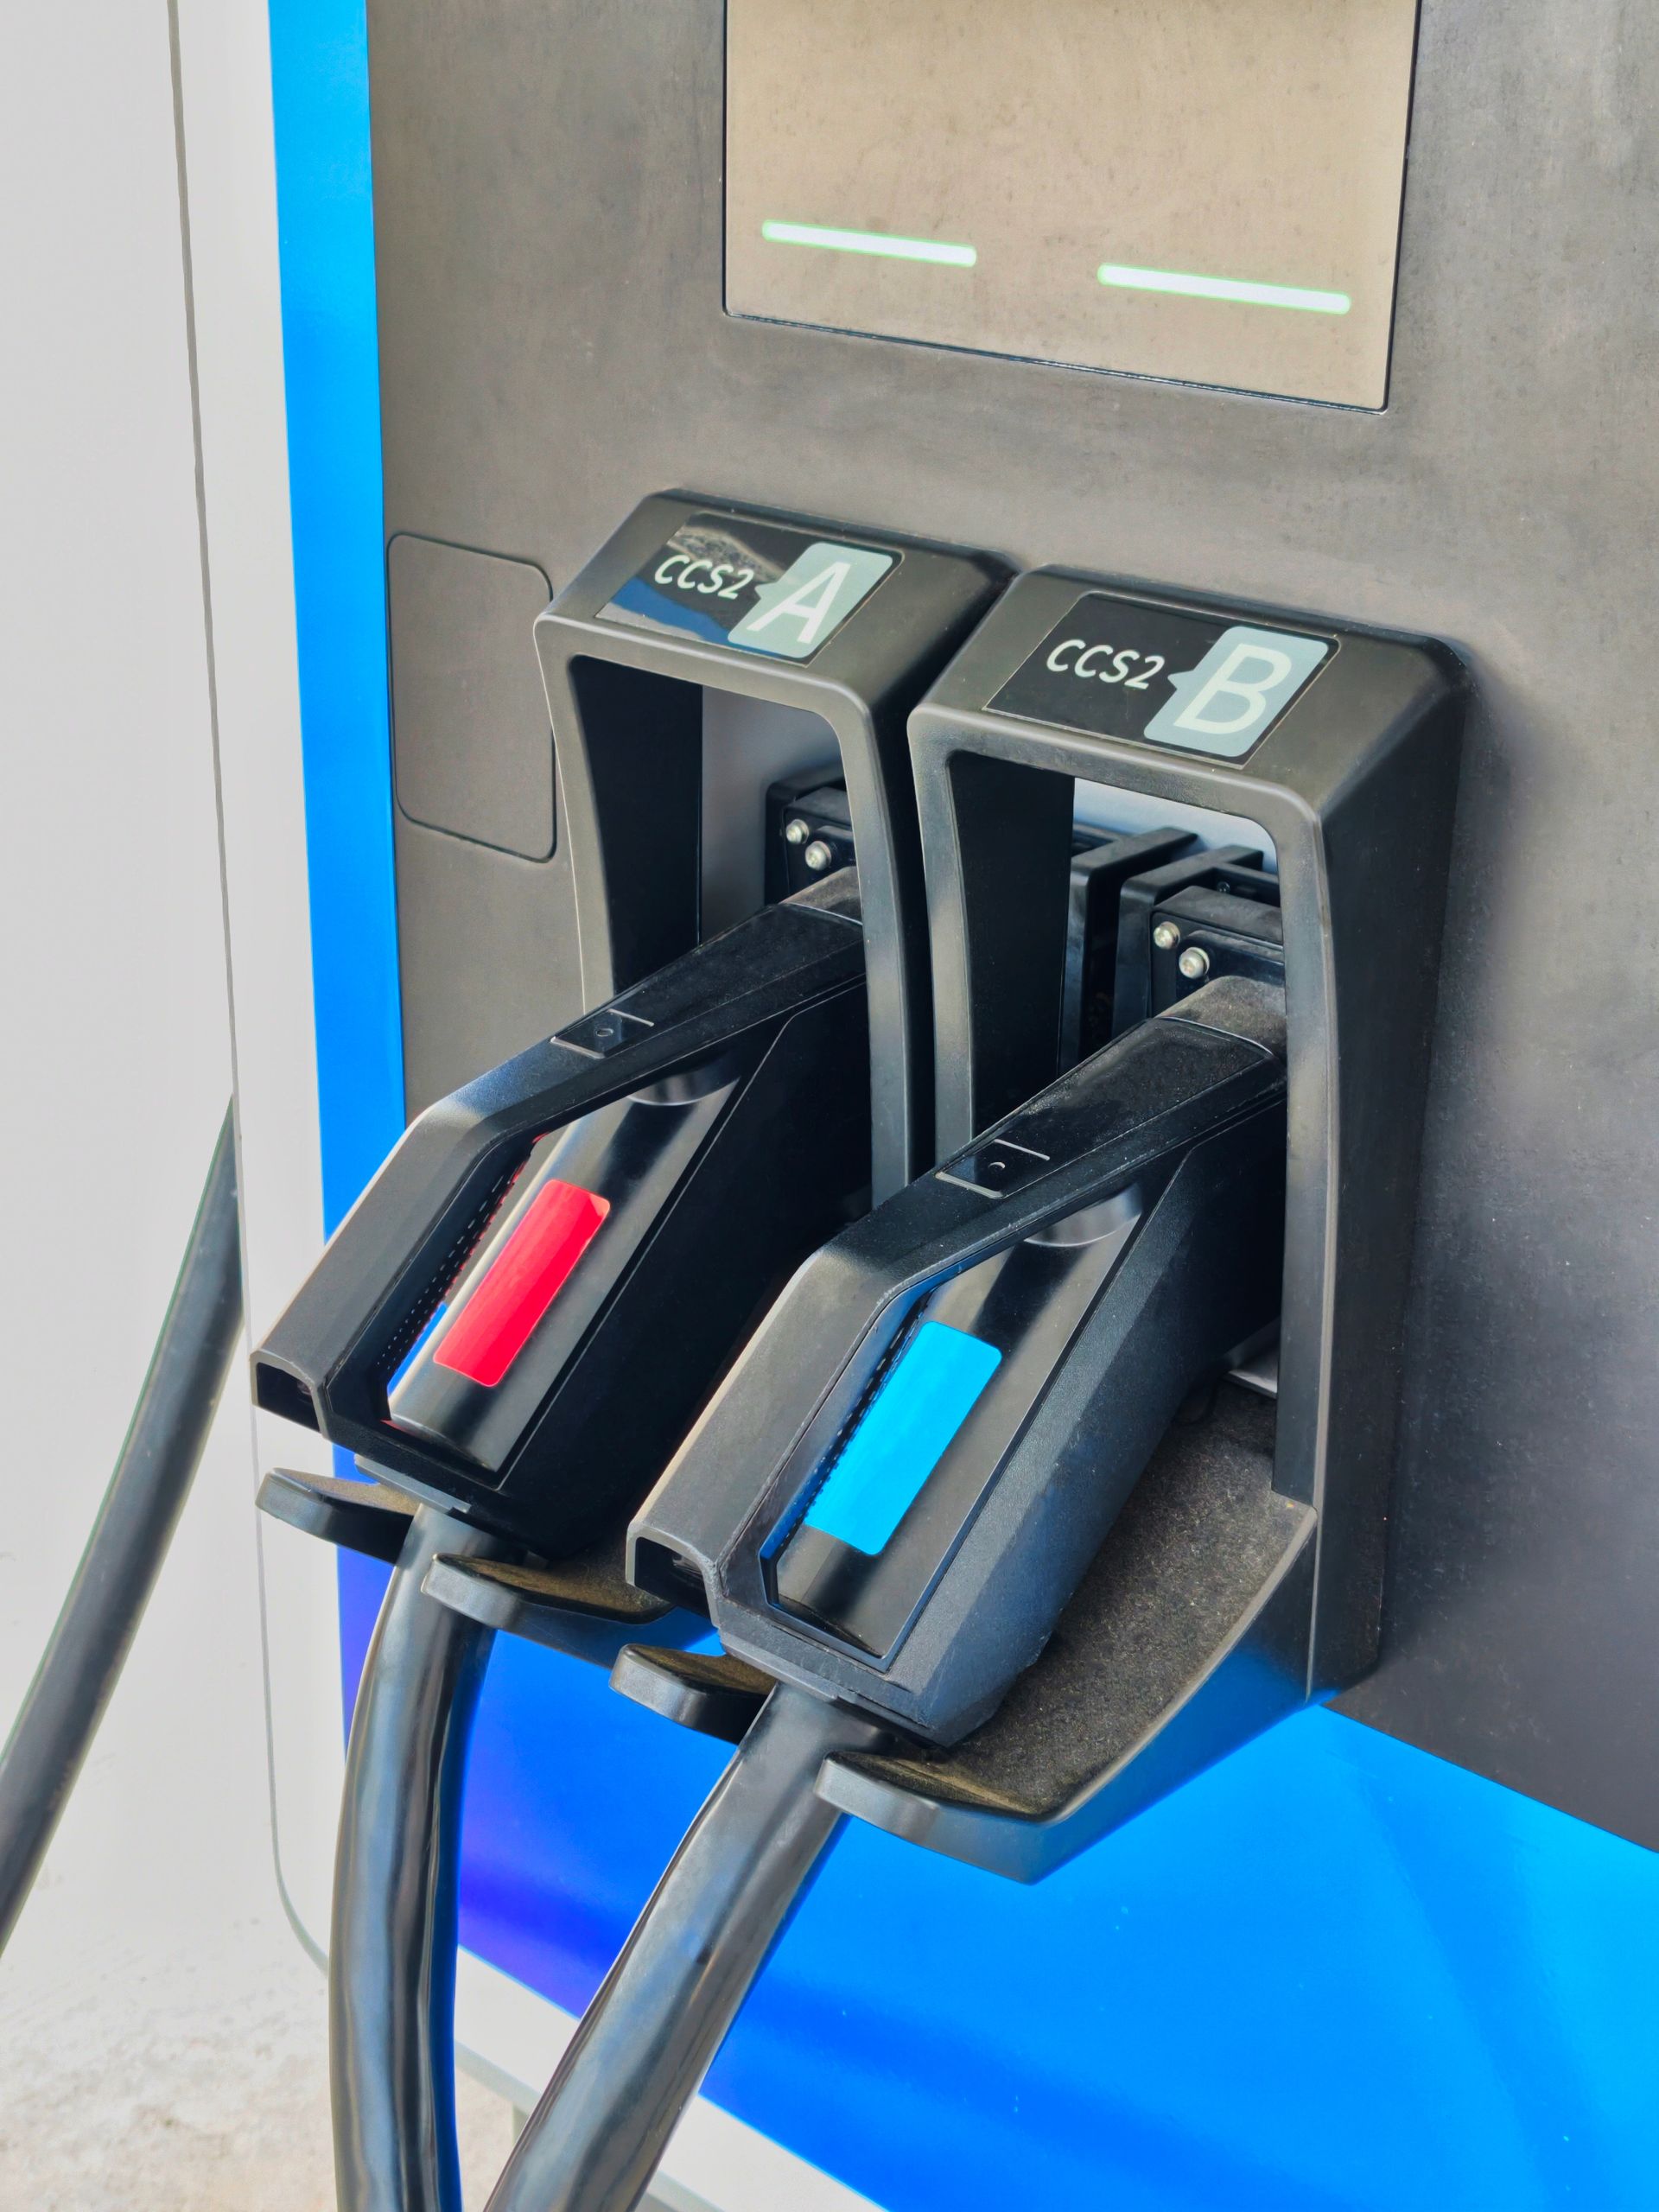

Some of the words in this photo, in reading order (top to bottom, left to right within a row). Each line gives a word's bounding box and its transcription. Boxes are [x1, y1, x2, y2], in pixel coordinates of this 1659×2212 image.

[654, 555, 754, 600] CCS2
[746, 562, 851, 644] A
[1046, 639, 1165, 690] CCS2
[1173, 643, 1293, 734] B
